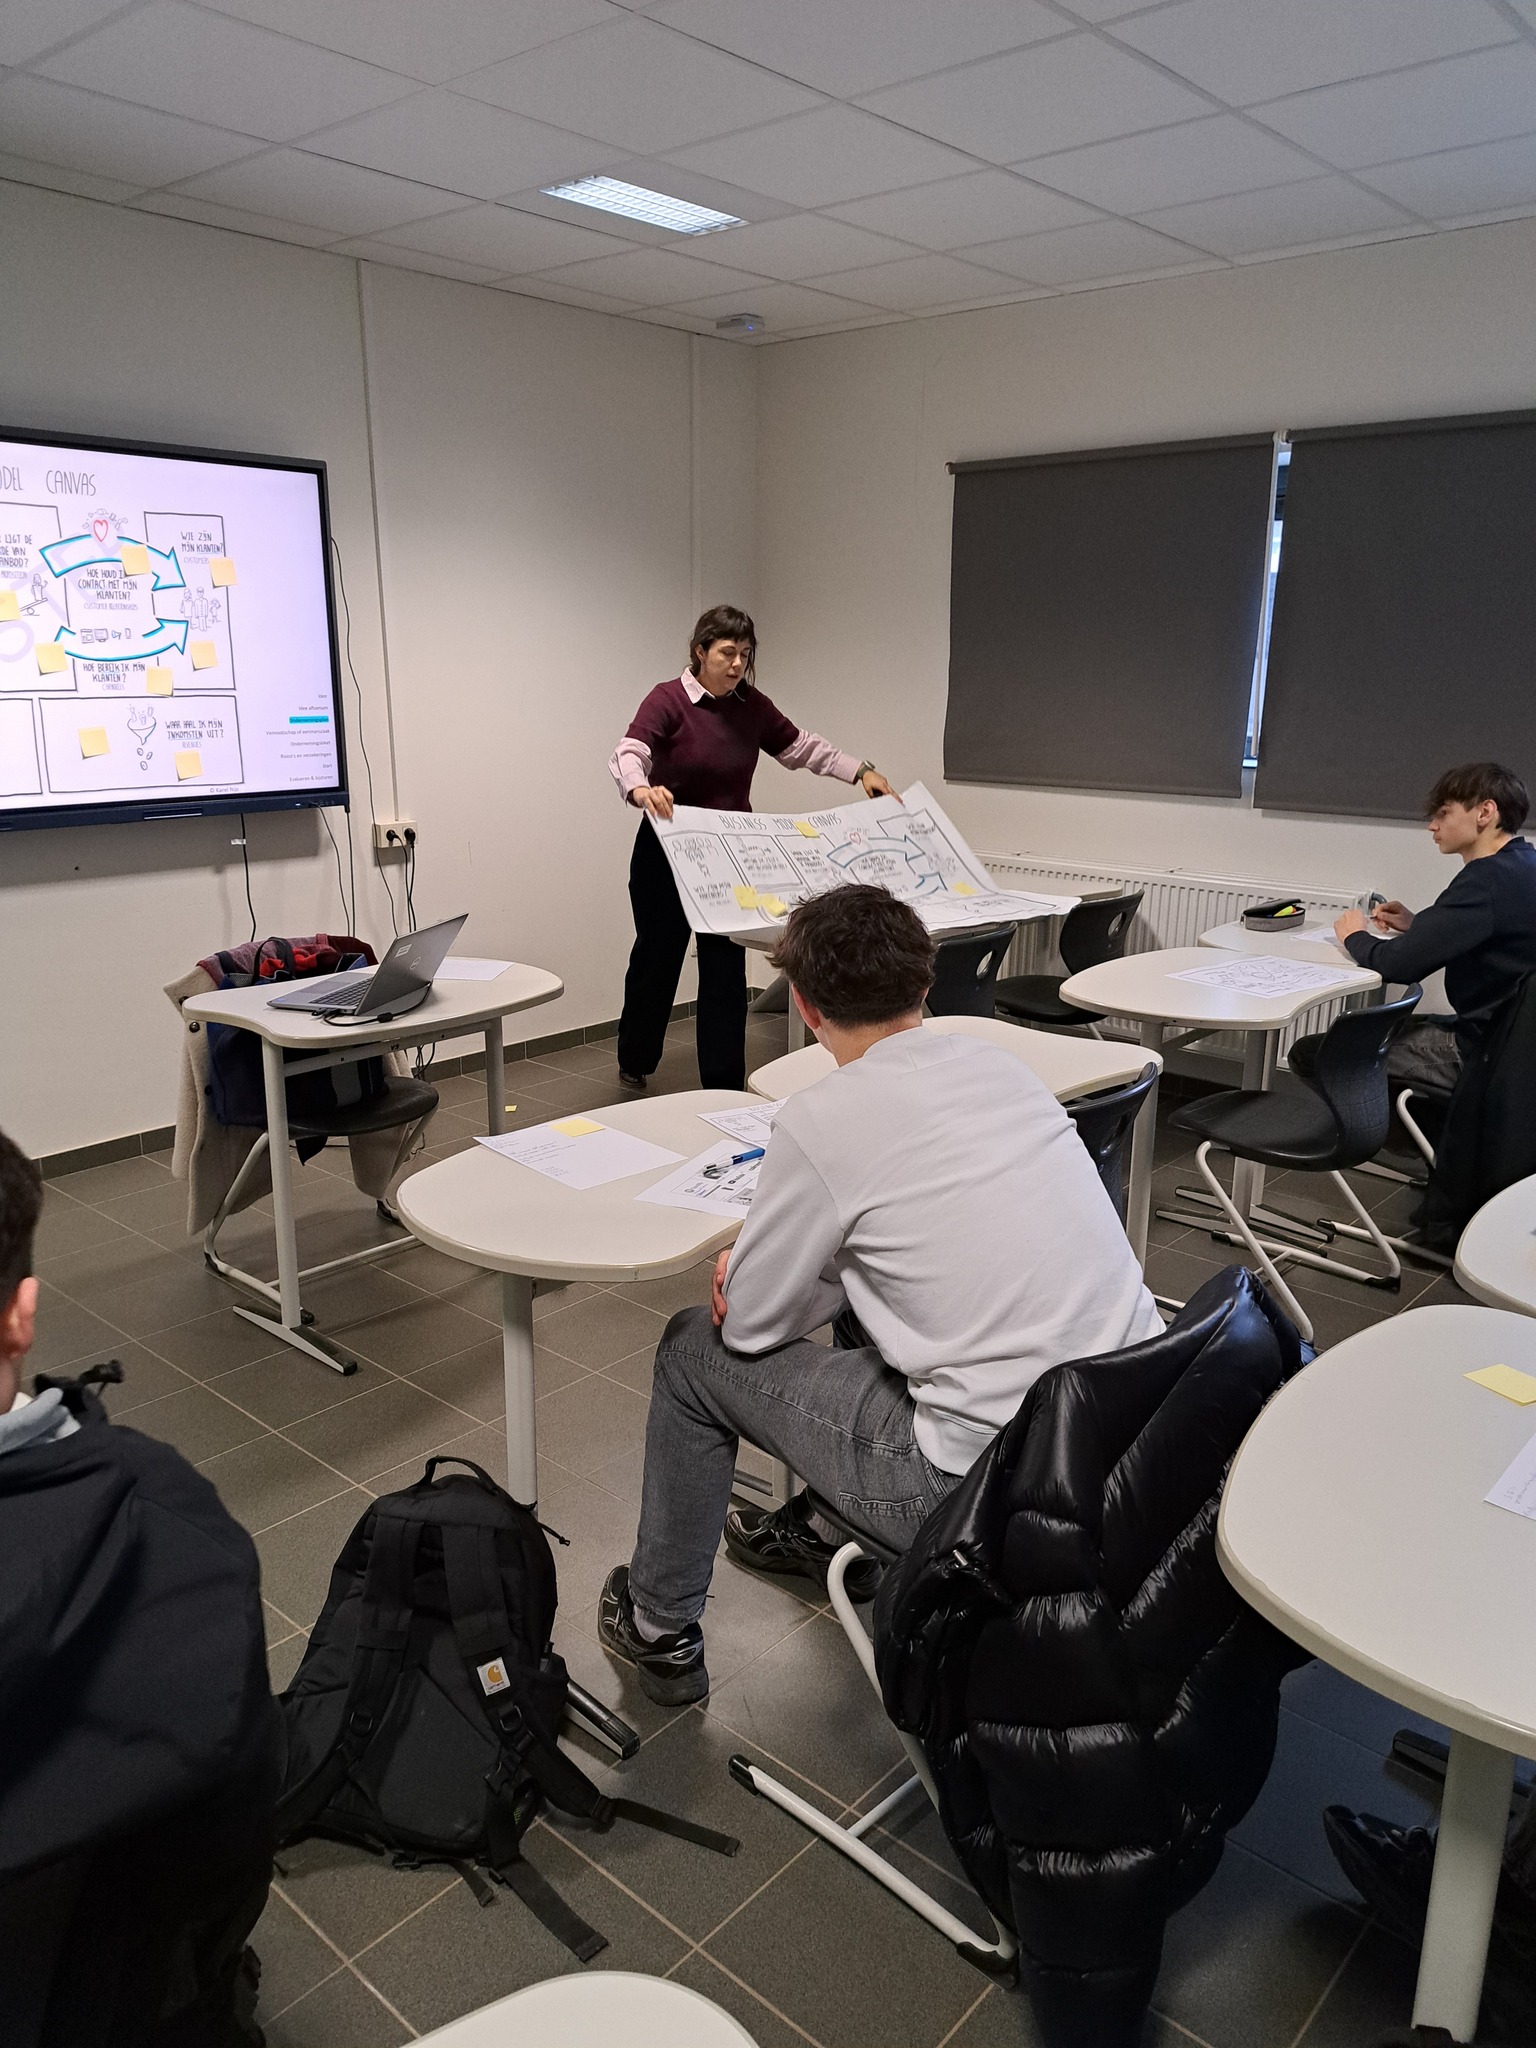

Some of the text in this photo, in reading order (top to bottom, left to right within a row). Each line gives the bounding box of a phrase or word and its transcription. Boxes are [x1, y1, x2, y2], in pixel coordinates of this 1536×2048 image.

[0, 465, 97, 497] DEL CANVAS
[4, 533, 32, 545] LIGT DE
[180, 531, 194, 541] WIE
[12, 546, 26, 556] VAN
[196, 542, 224, 553] KLANTEN?
[86, 568, 99, 579] HOE
[101, 569, 117, 579] HOUD
[78, 578, 105, 590] CONTACT
[108, 579, 120, 590] MET
[96, 590, 131, 601] KLANTEN?
[82, 662, 95, 672] HOE
[97, 662, 120, 673] BEREIK
[121, 662, 130, 672] IK
[165, 720, 181, 729] WAAR
[183, 720, 196, 729] HAAL
[198, 720, 207, 729] IK
[167, 730, 203, 740] INKOMSTEN
[718, 814, 768, 831] BUSINESS
[807, 811, 842, 829] CANVAS
